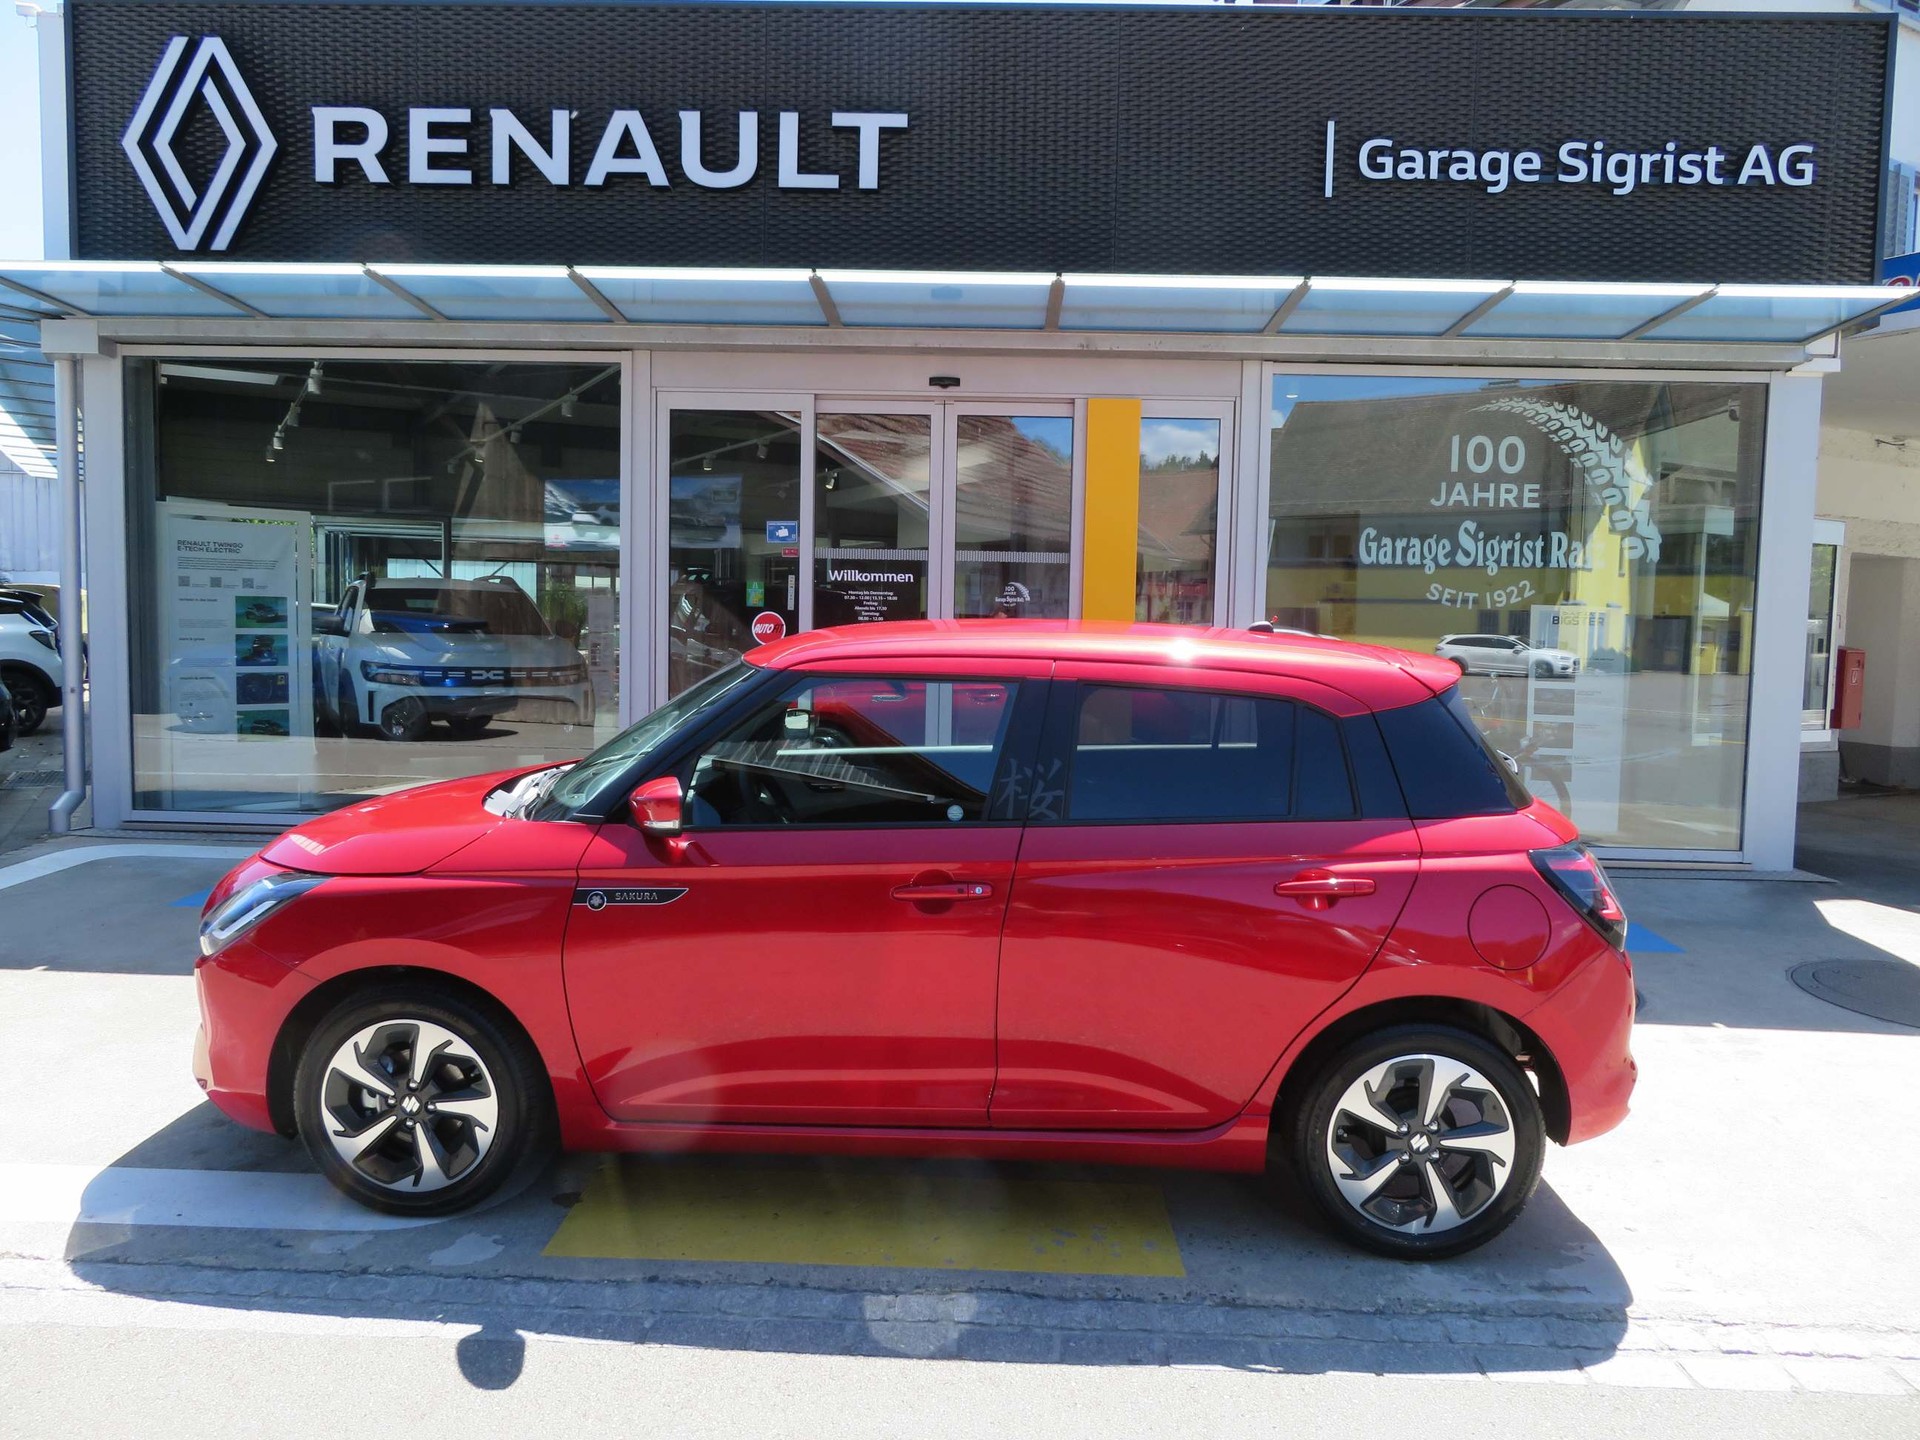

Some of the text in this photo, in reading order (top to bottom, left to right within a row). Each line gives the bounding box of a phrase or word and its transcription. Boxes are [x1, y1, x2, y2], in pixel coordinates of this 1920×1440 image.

[311, 106, 909, 190] RENAULT
[1358, 138, 1815, 196] Garage Sigrist AG
[1450, 434, 1526, 474] 100
[1430, 482, 1540, 508] JAHRE
[177, 539, 244, 549] RENAULT TWINGO
[1358, 526, 1451, 575] Garage
[1455, 520, 1545, 576] Sigrist
[828, 569, 914, 582] Willkommen
[1426, 580, 1536, 610] SEIT 1922
[996, 758, 1065, 820] 桜
[615, 892, 658, 901] SAKURA
